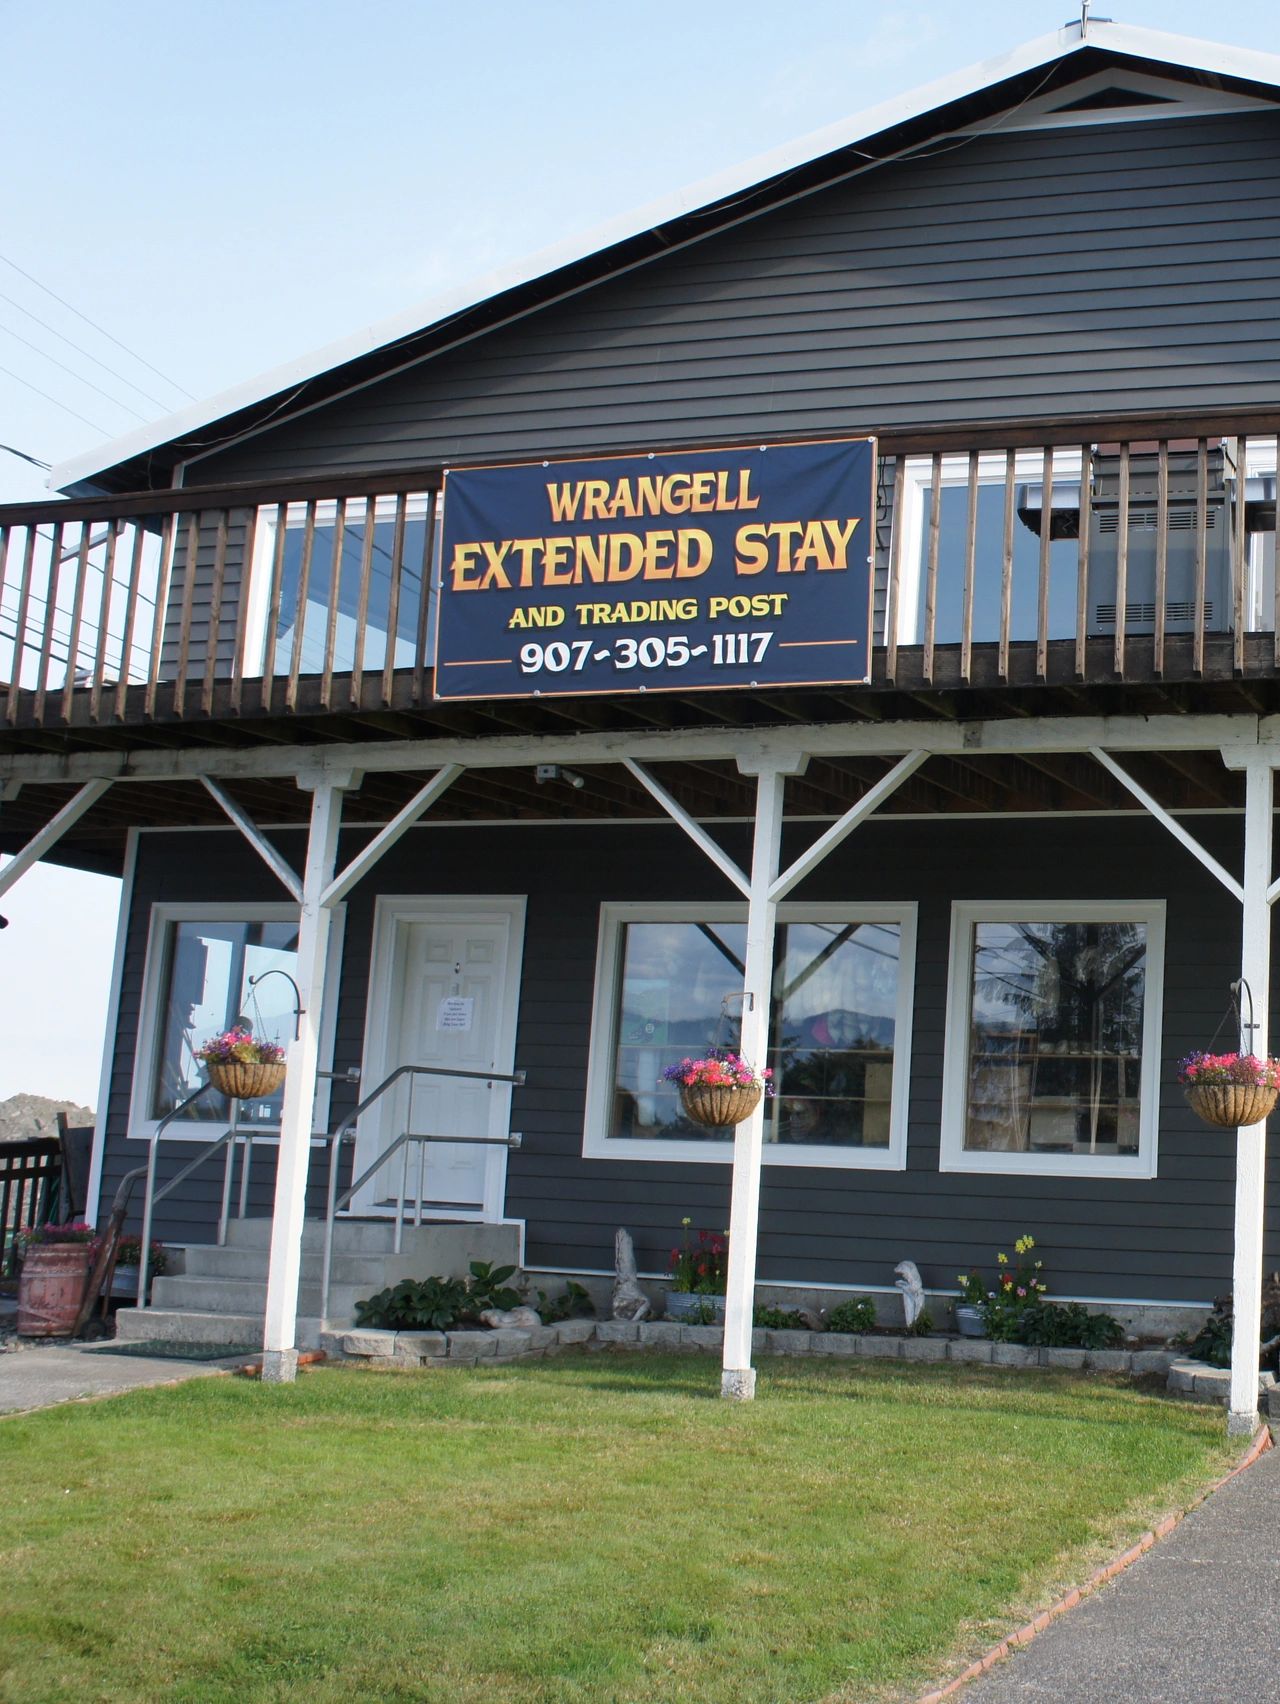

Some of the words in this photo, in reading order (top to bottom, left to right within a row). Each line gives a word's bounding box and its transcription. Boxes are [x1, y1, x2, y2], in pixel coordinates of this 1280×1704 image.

[546, 469, 760, 522] WRANGELL
[450, 528, 713, 591] EXTENDED
[734, 518, 862, 576] STAY
[508, 605, 565, 629] AND
[575, 598, 698, 625] TRADING
[709, 593, 788, 618] POST
